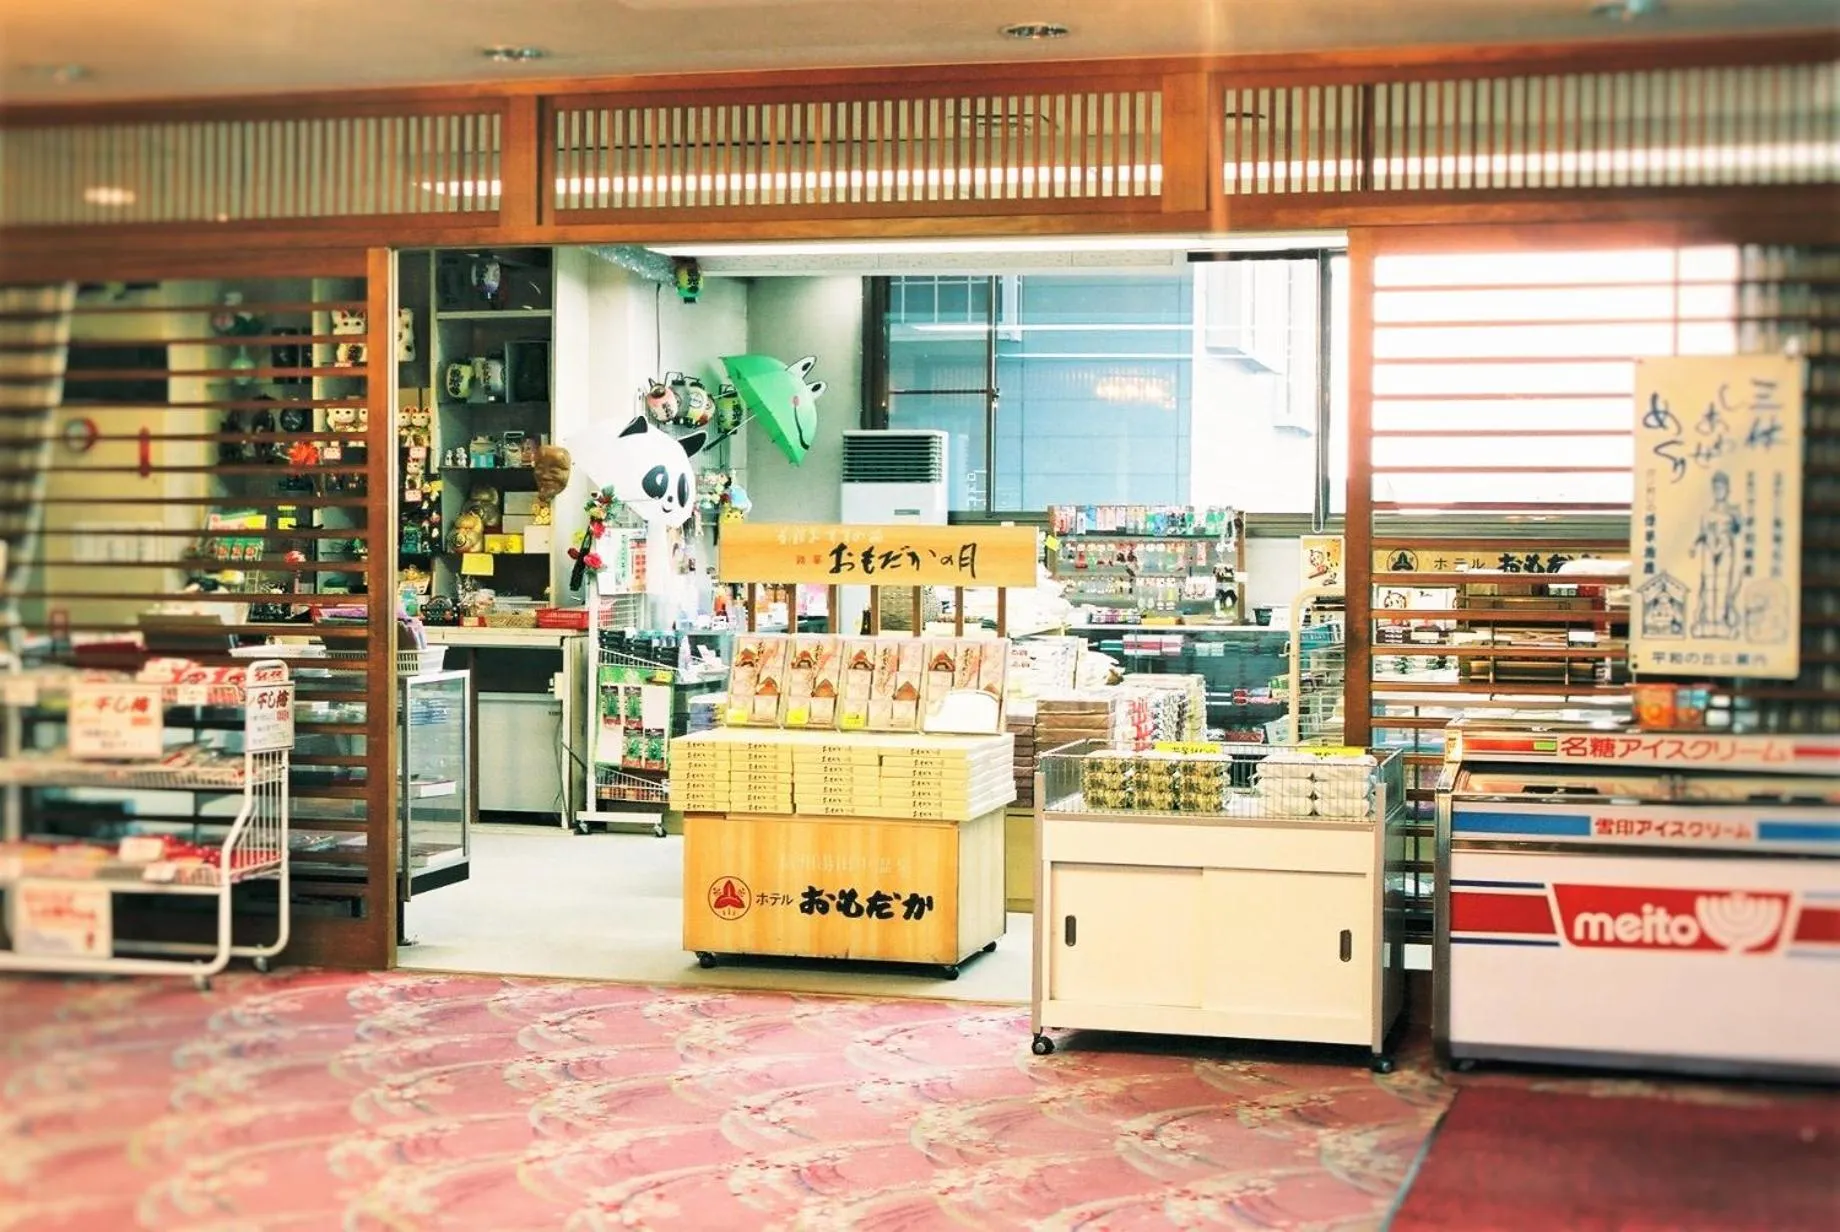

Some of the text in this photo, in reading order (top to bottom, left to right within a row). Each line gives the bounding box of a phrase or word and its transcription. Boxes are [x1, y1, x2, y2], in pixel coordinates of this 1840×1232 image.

[829, 542, 977, 578] おもだかの月
[1498, 551, 1604, 573] おもだ
[1560, 736, 1787, 763] 名糖アイスクリーム
[1594, 817, 1751, 839] 雪印アイスクリーム
[755, 885, 934, 920] ホテル おもだか
[1573, 903, 1702, 946] meito
